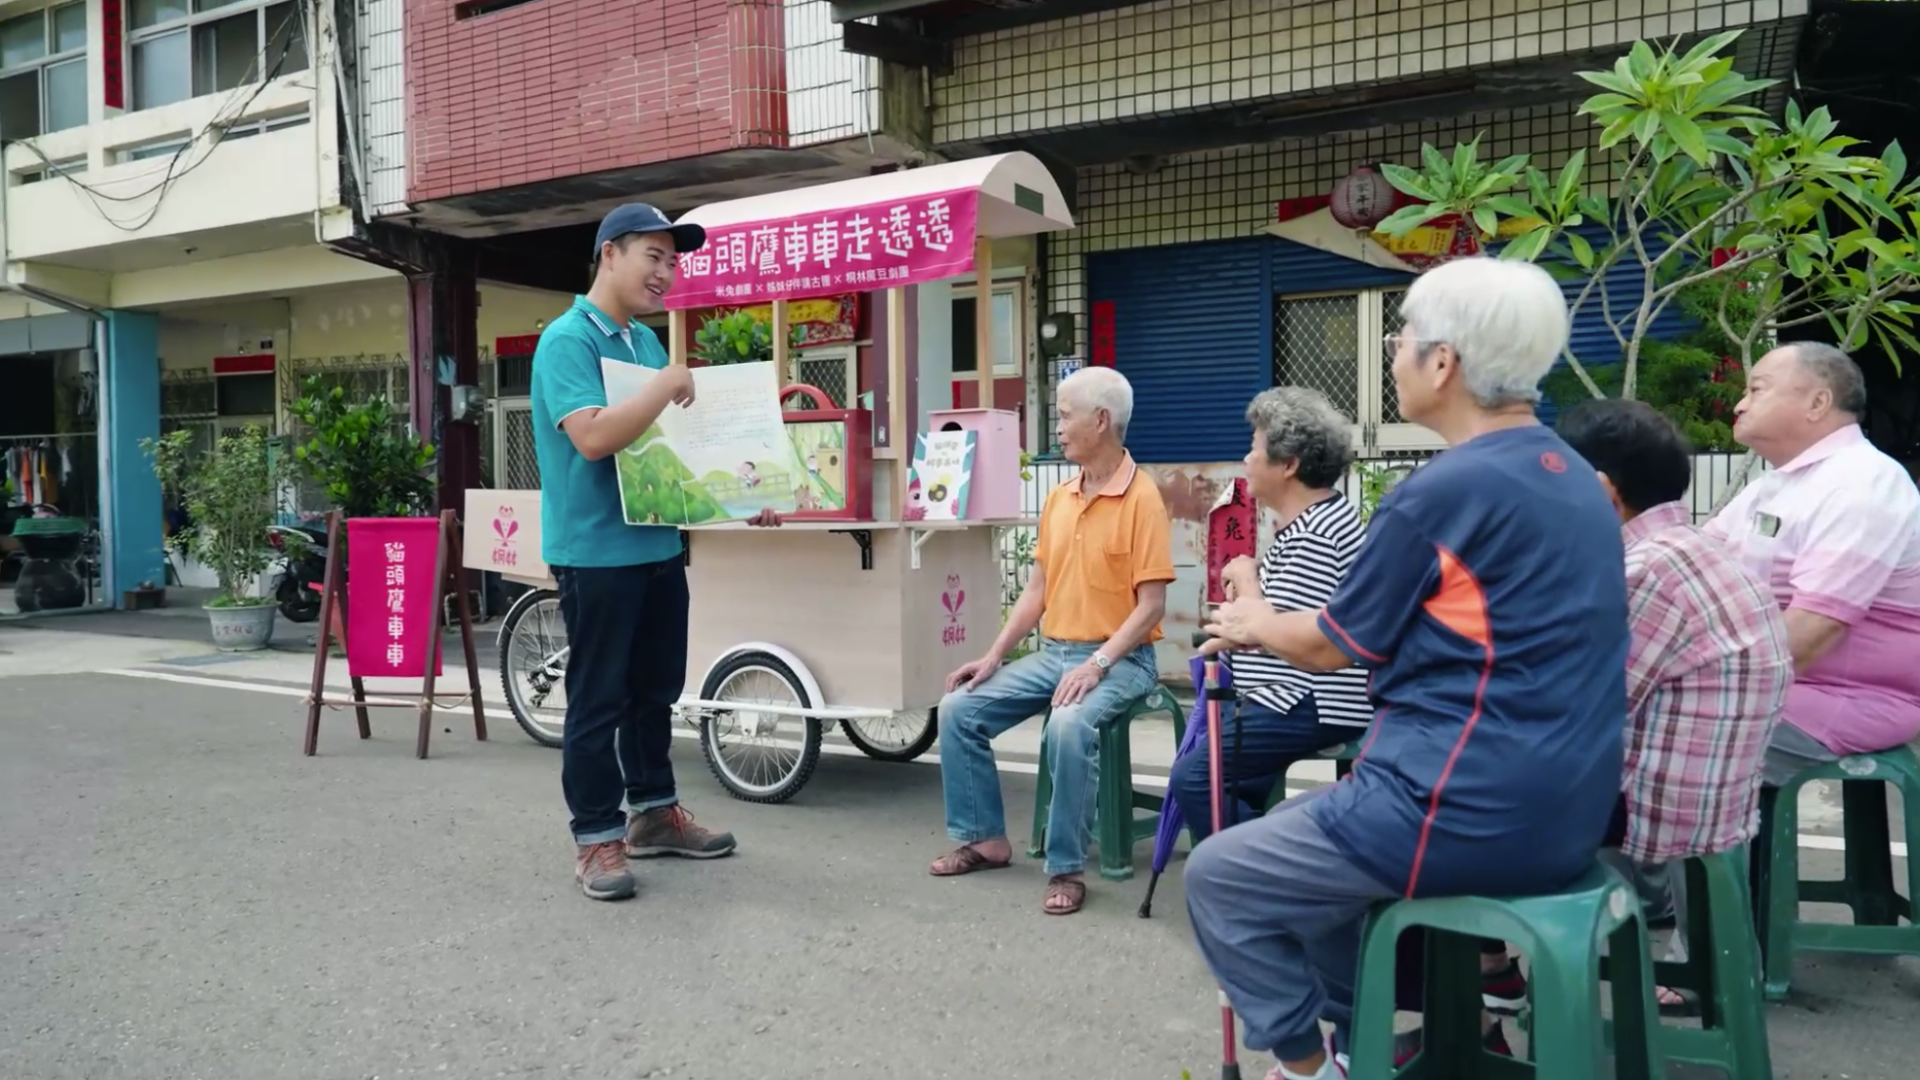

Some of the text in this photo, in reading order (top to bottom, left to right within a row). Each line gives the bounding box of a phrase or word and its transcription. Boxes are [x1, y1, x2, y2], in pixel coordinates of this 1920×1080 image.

[680, 198, 953, 279] 貓頭鷹車車走透透
[384, 542, 405, 668] 貓頭鷹車車
